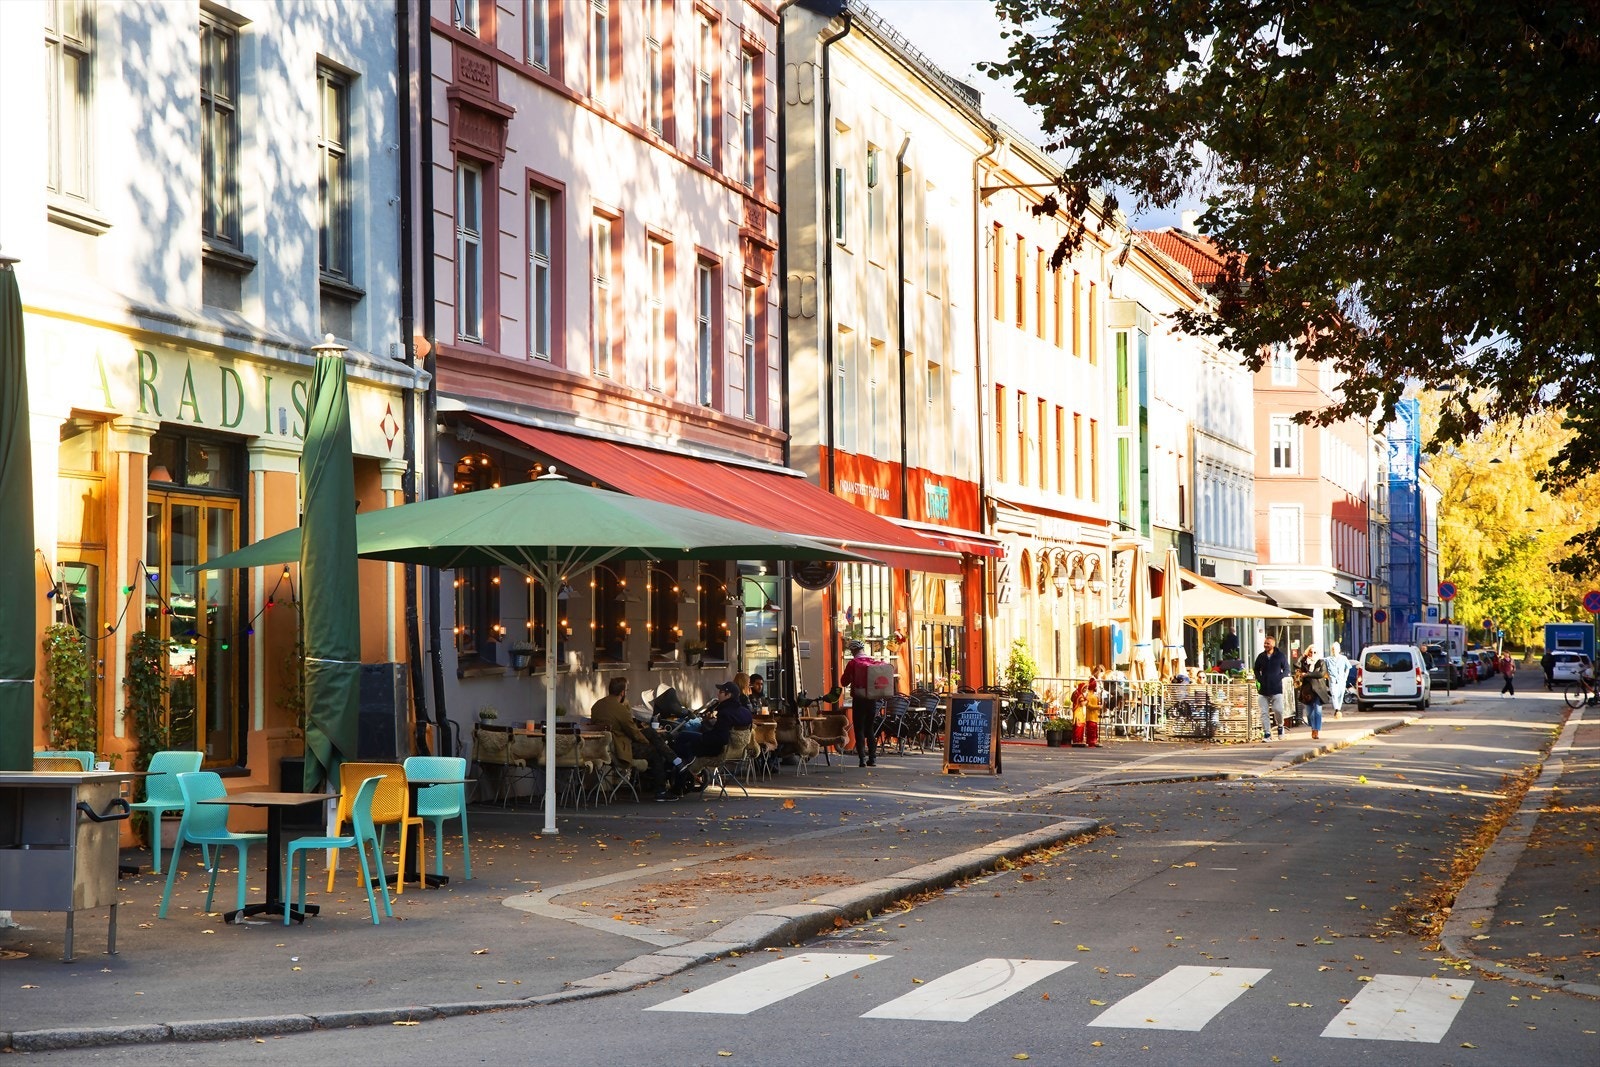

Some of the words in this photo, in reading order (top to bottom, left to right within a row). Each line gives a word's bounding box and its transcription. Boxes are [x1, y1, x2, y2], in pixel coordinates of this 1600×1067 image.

[839, 479, 855, 494] INDIAN
[854, 482, 868, 496] STREET
[868, 486, 880, 499] FOOD
[882, 489, 890, 501] BAR
